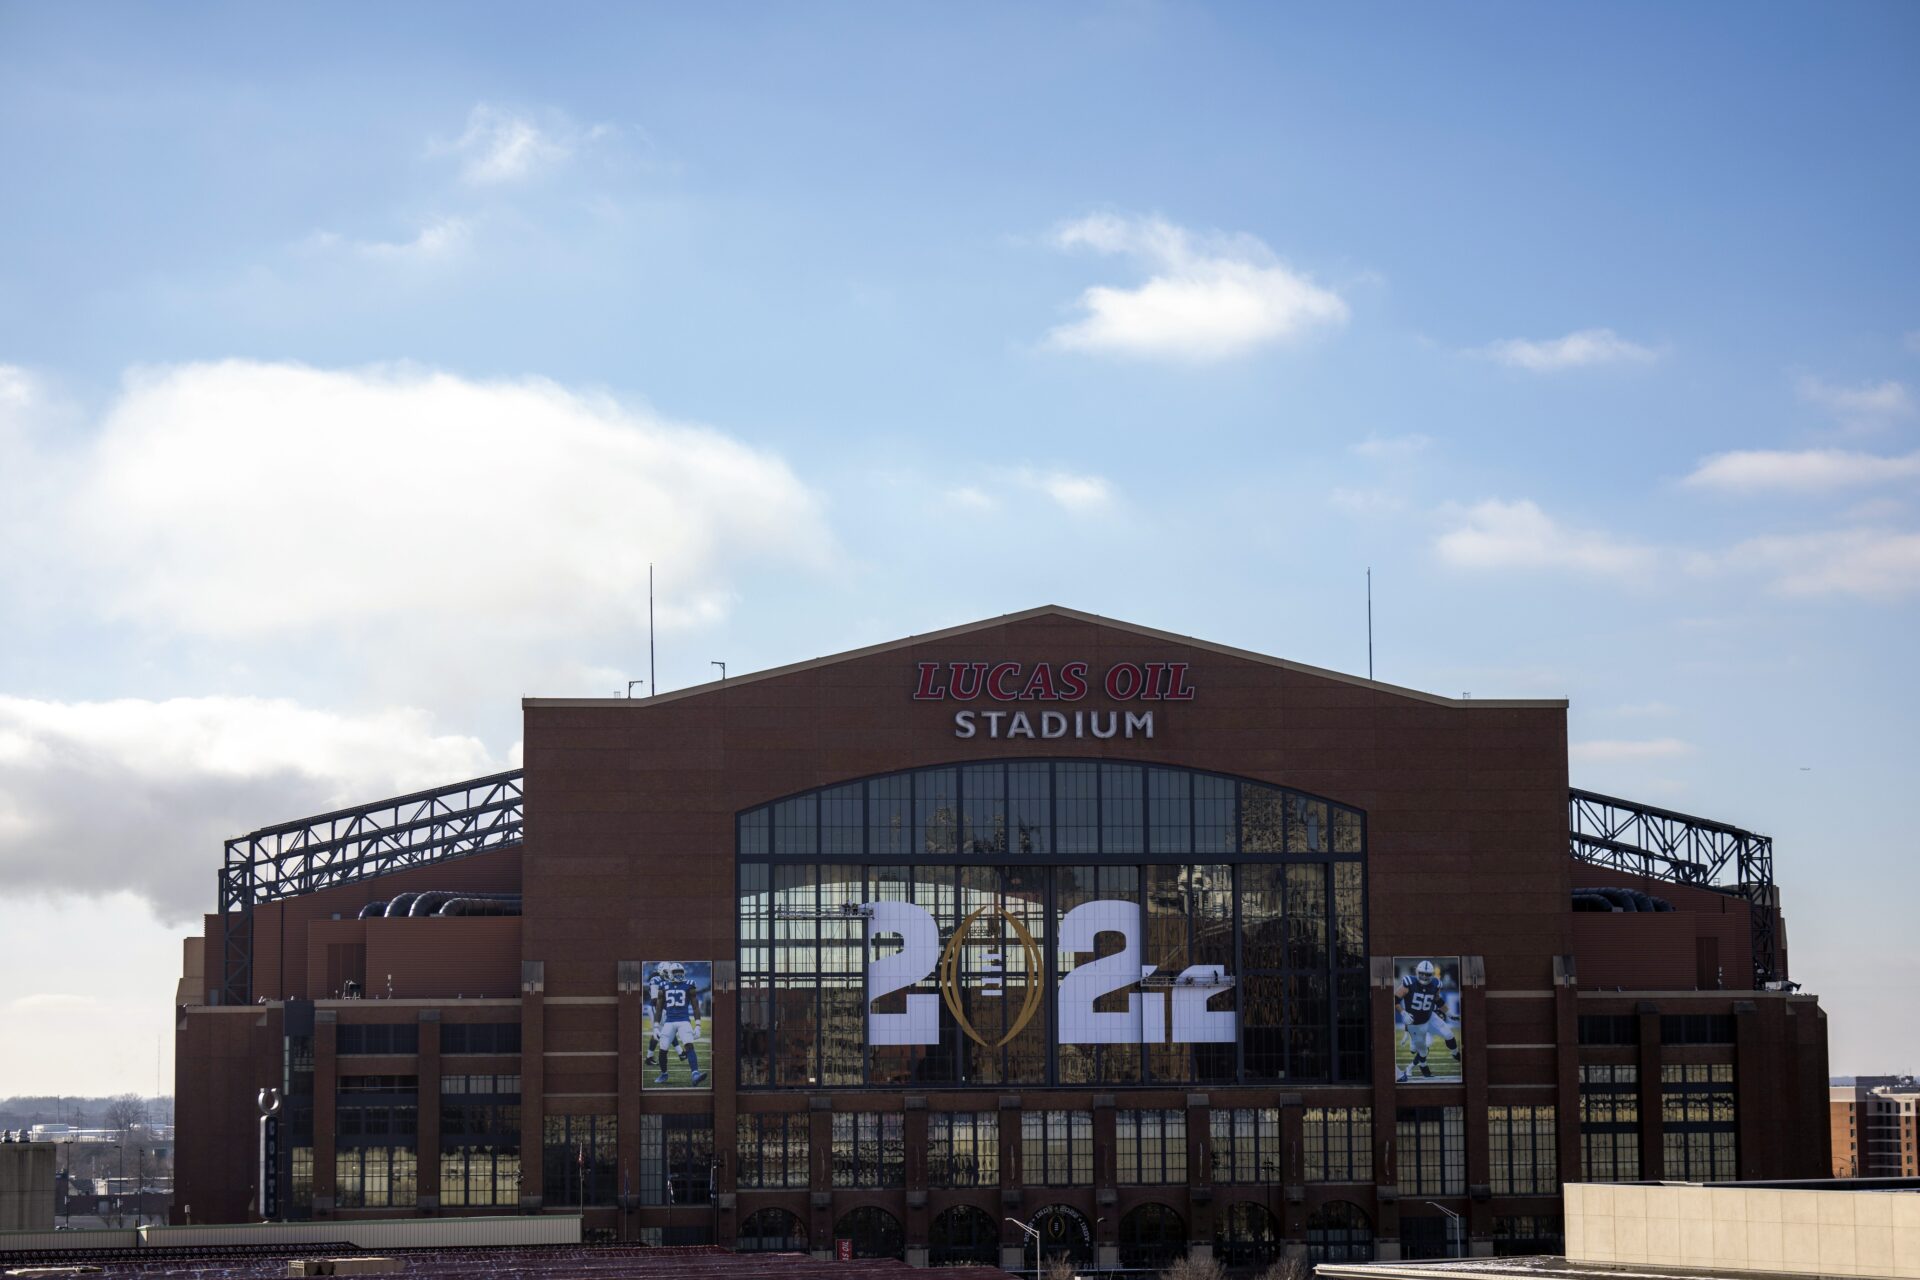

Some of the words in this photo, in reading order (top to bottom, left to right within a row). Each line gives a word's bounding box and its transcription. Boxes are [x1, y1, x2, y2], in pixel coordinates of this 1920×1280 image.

[912, 661, 1089, 702] LUCAS
[1104, 661, 1196, 701] OIL
[954, 709, 1154, 739] STADIUM
[665, 989, 686, 1007] 53
[1411, 992, 1434, 1010] 56
[1034, 1205, 1053, 1219] INDY
[1080, 1222, 1090, 1242] INDY
